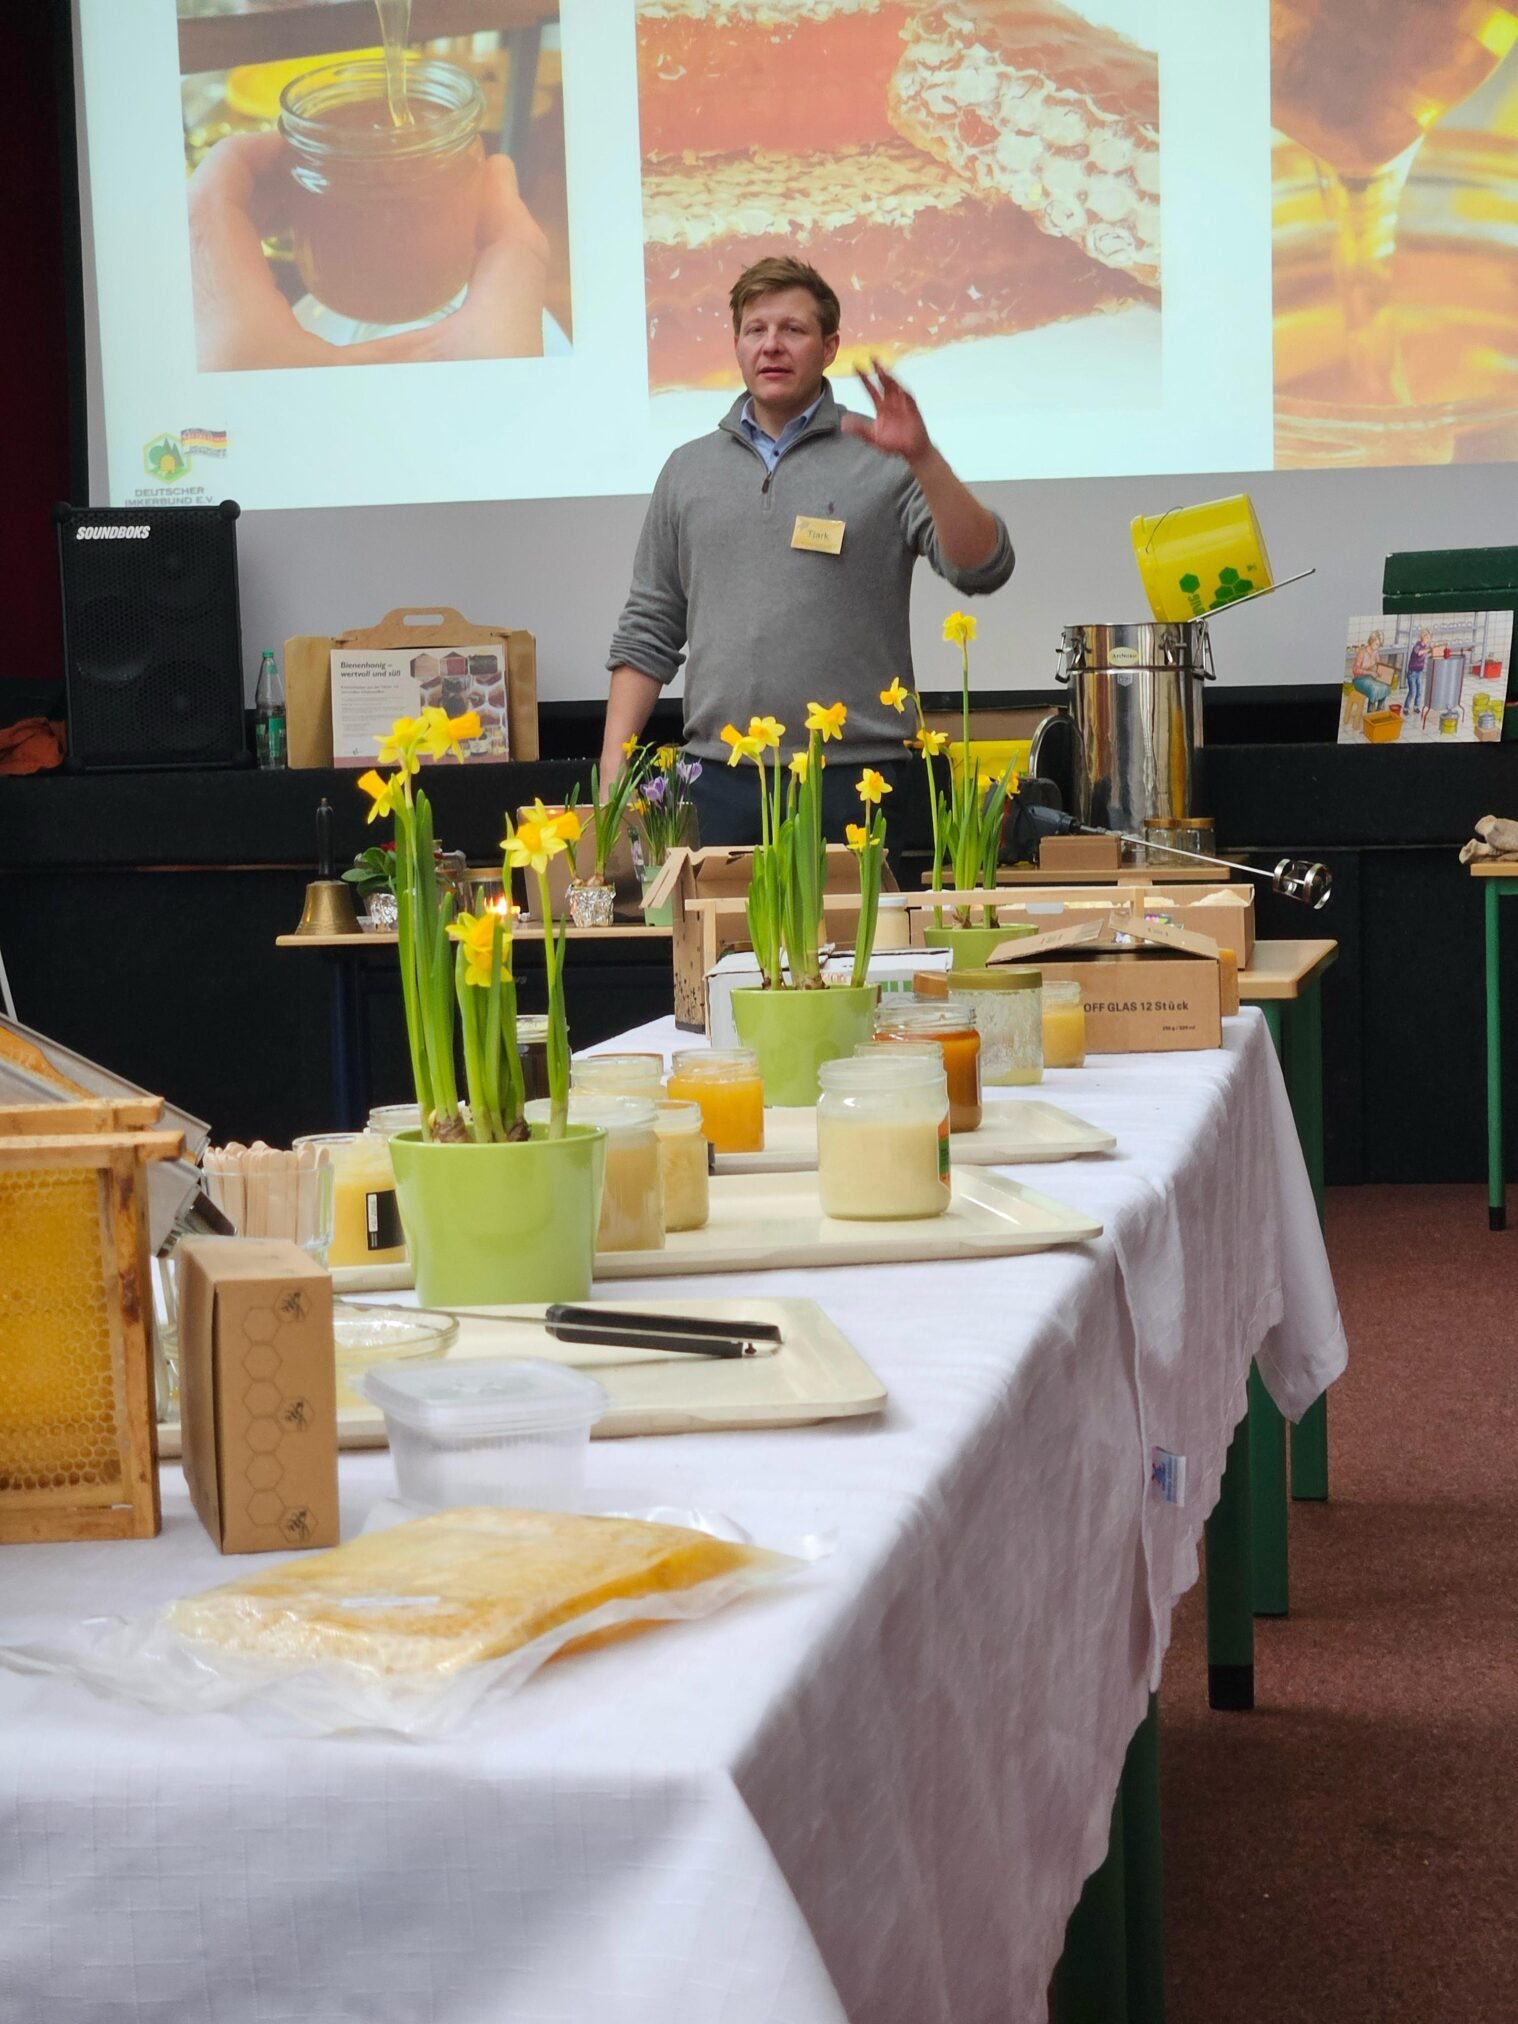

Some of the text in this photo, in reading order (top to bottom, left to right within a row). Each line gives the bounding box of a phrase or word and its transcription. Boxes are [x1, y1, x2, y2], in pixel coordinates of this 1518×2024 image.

[135, 487, 205, 497] DEUTSCHER
[125, 497, 192, 508] IMKERBUND
[76, 525, 151, 540] SOUNDBOKS
[340, 661, 386, 670] Bienenhonig
[340, 670, 371, 678] wertvoll
[372, 670, 387, 678] und
[1083, 1001, 1189, 1013] OFF GLAS 12 Stück
